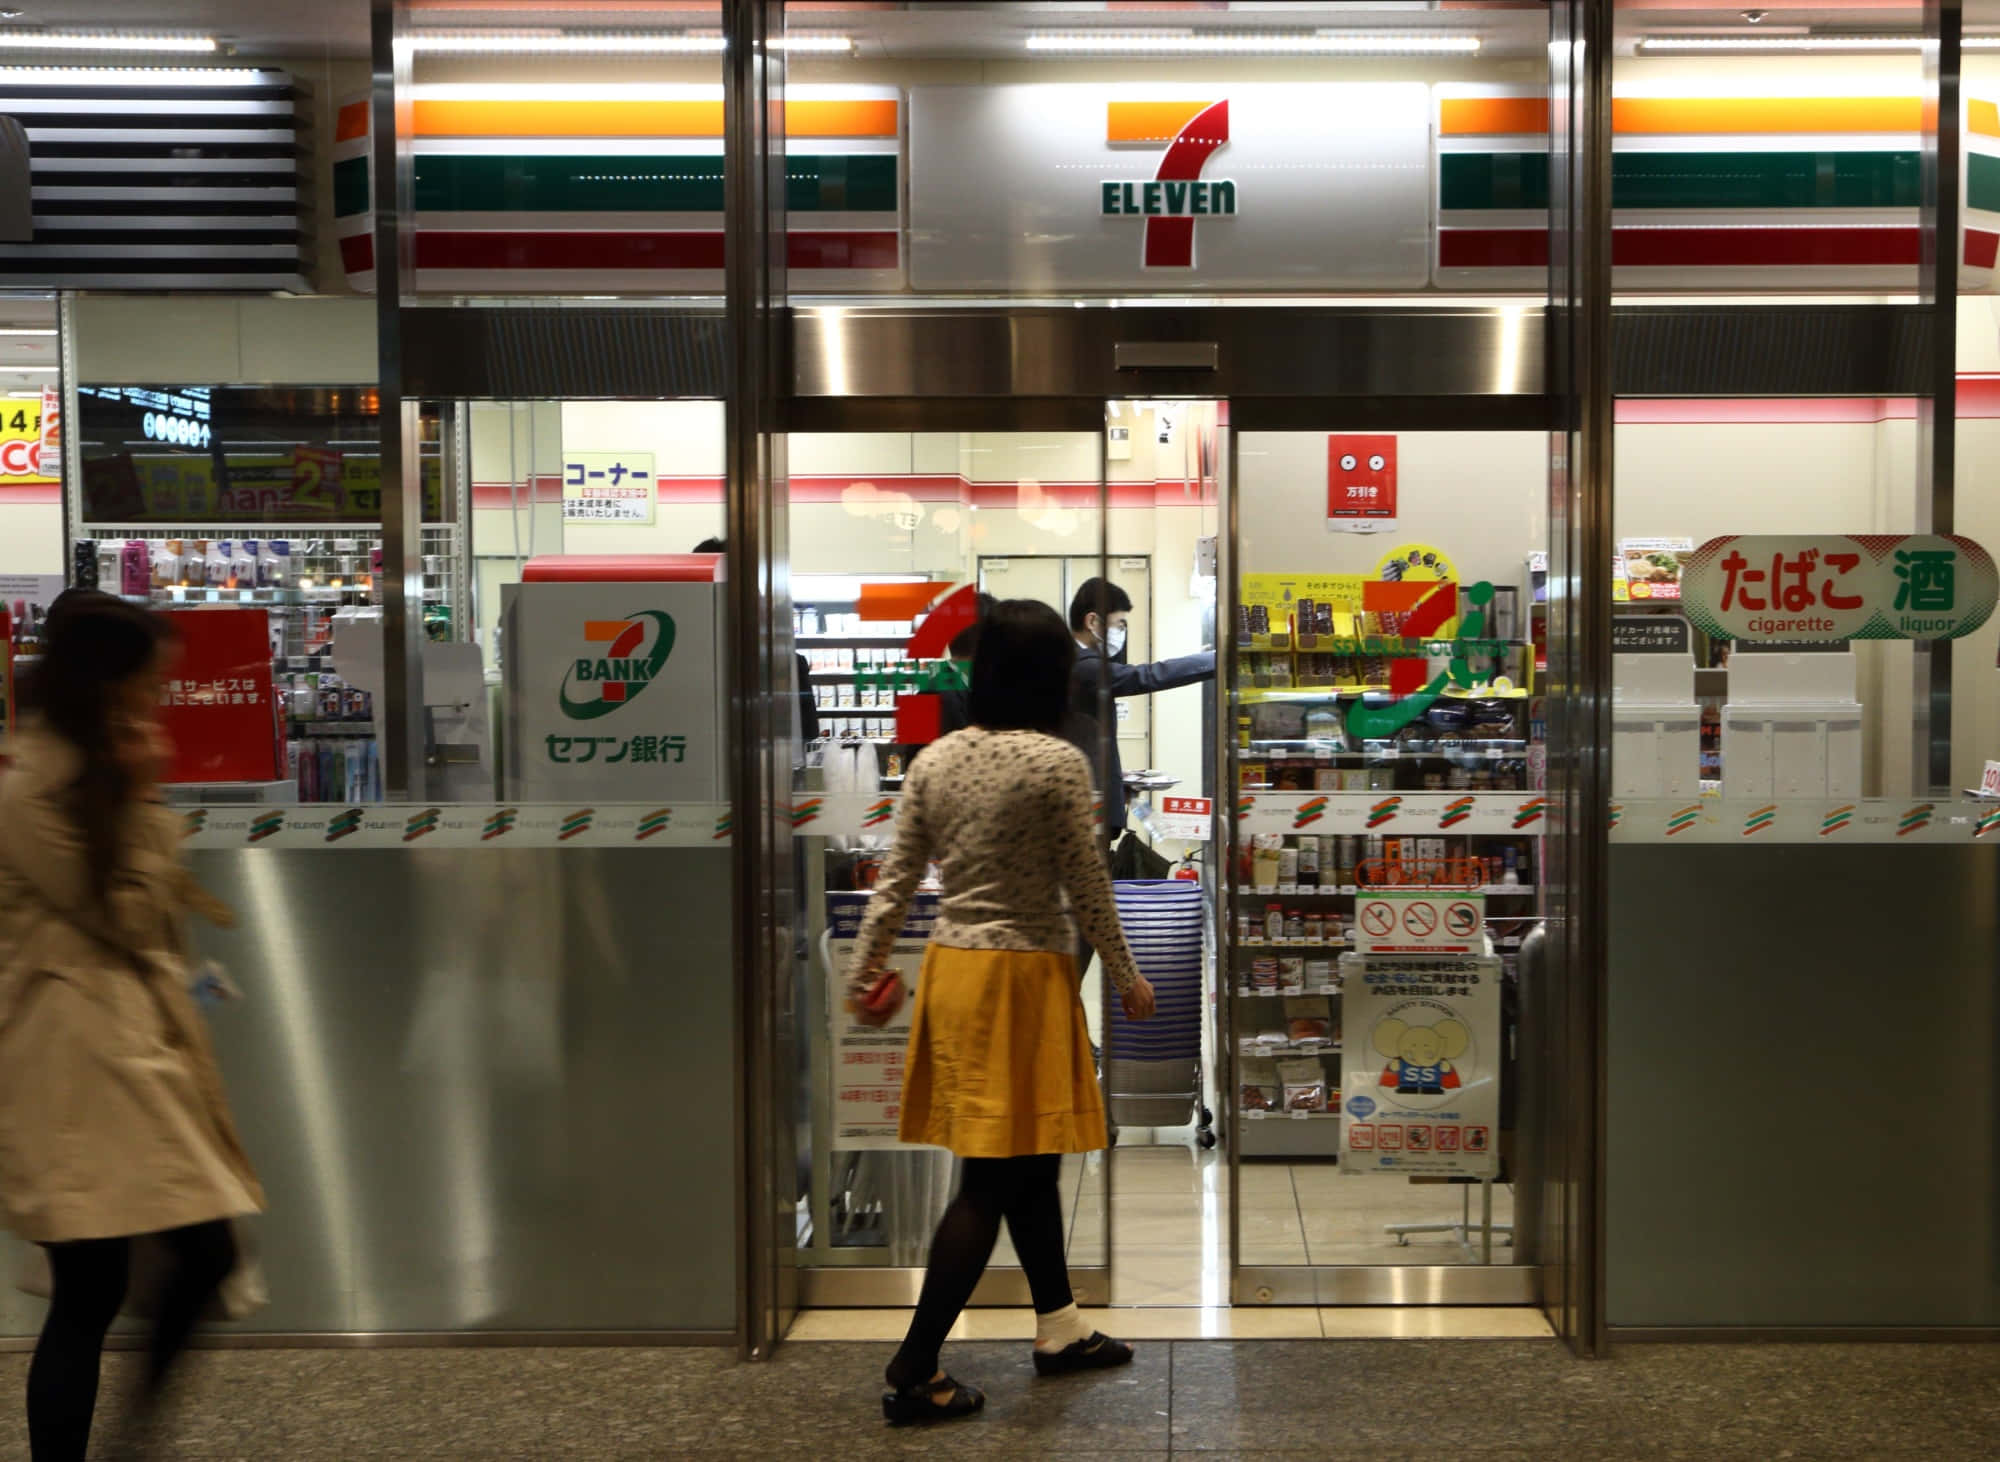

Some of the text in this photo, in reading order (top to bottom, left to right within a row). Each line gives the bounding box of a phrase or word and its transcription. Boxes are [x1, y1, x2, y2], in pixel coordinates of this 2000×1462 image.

[1107, 98, 1229, 267] 7
[566, 462, 649, 486] コーナー
[1720, 548, 1864, 613] たばこ
[1893, 549, 1957, 612] 酒
[1748, 615, 1836, 635] cigarette
[1900, 615, 1957, 634] liquor
[576, 658, 652, 681] BANK
[544, 733, 687, 763] セブン銀行
[1404, 1067, 1437, 1083] SS
